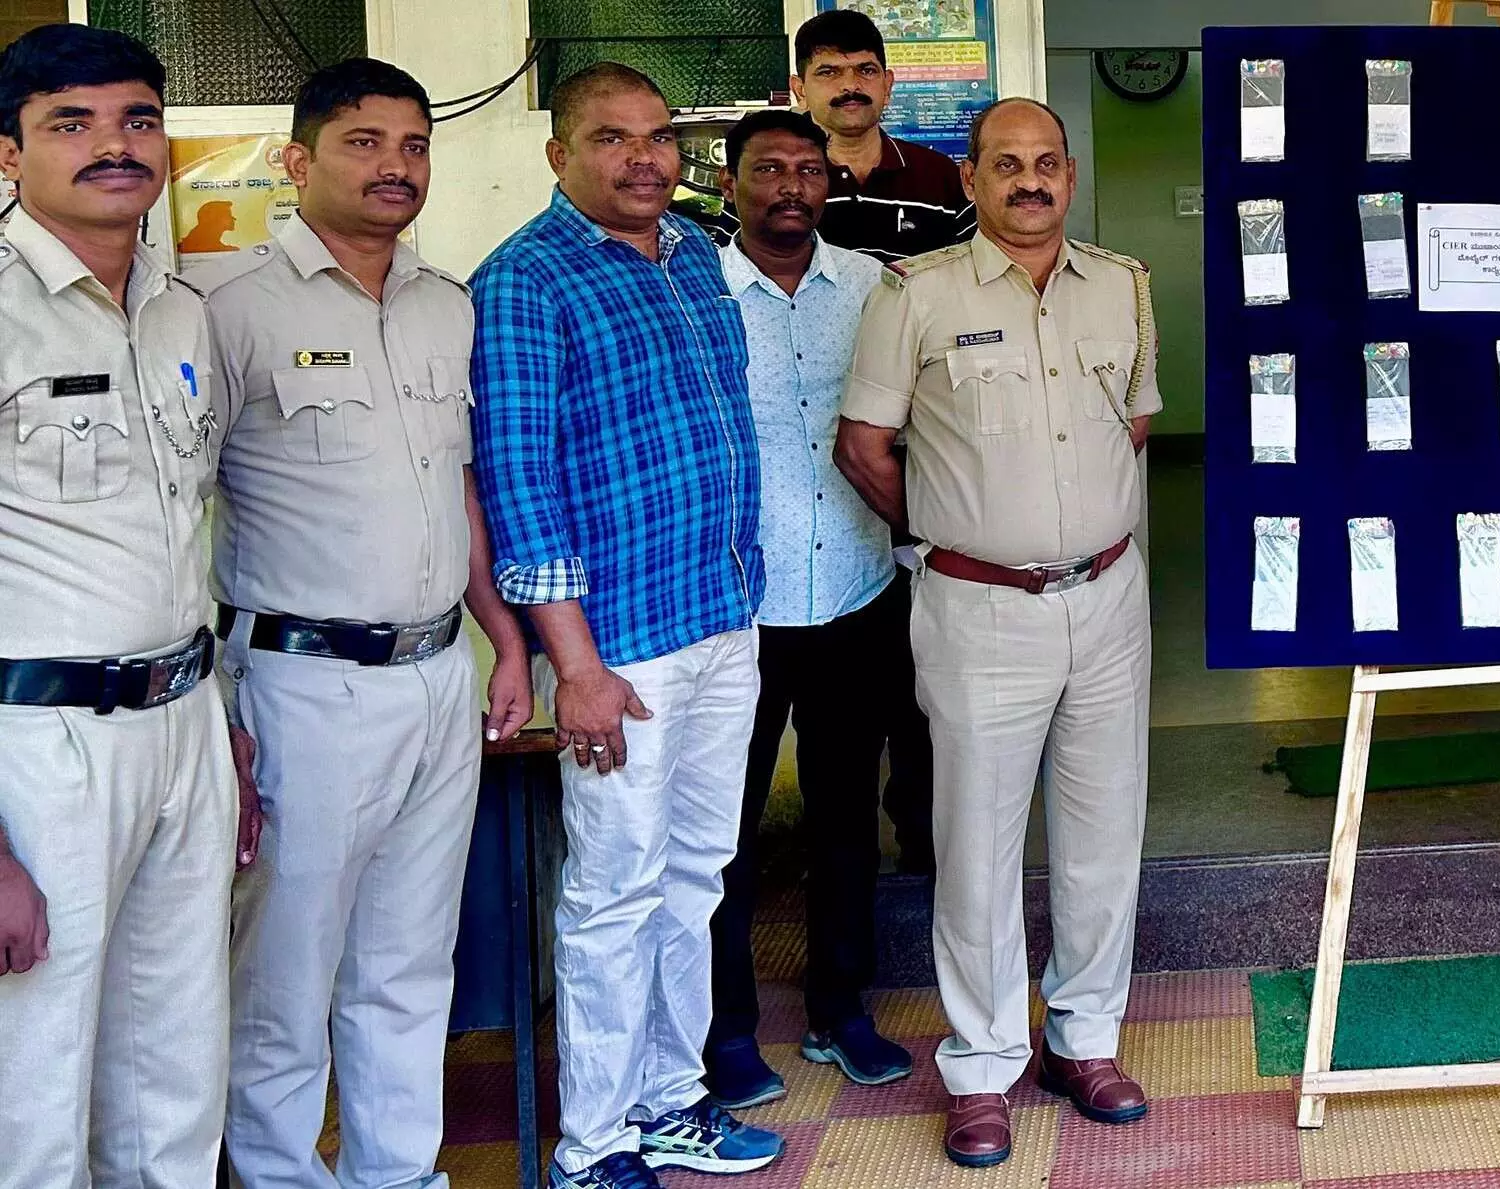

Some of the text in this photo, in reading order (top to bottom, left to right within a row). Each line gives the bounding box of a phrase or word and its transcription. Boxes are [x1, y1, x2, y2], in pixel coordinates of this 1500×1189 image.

[1113, 64, 1121, 76] 8
[1138, 78, 1146, 89] 6
[191, 180, 240, 190] ಕರ್ನಾಟಕ
[247, 178, 275, 192] ರಾಜ್ಯ
[1442, 241, 1468, 250] CIER
